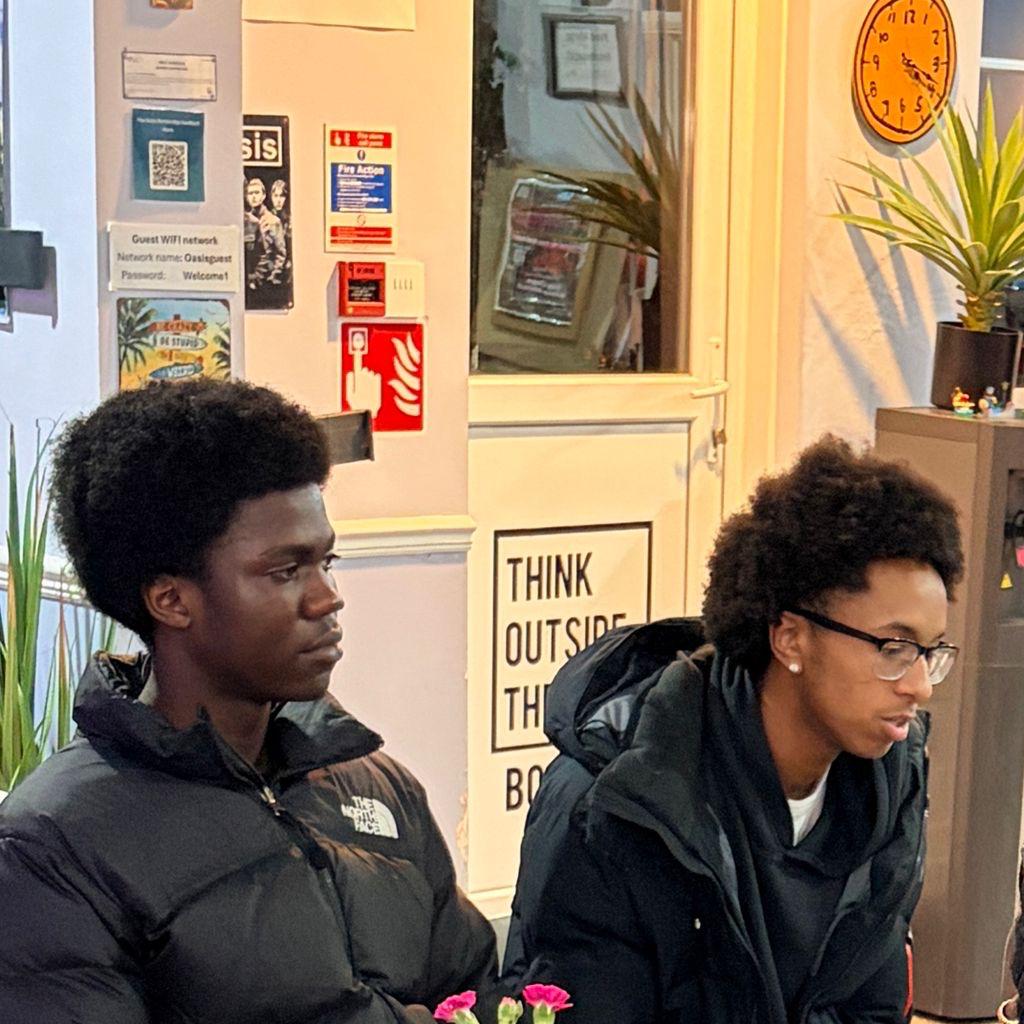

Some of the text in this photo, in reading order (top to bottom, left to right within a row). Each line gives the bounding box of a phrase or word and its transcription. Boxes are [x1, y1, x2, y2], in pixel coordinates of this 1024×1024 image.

[337, 164, 385, 175] Fire Action
[131, 234, 159, 244] Guest
[183, 236, 218, 245] network
[117, 253, 153, 262] Network
[184, 253, 233, 265] Oasisguest
[121, 271, 165, 280] Password:
[506, 551, 593, 602] THINK
[504, 684, 550, 731] TH
[505, 765, 543, 812] BO
